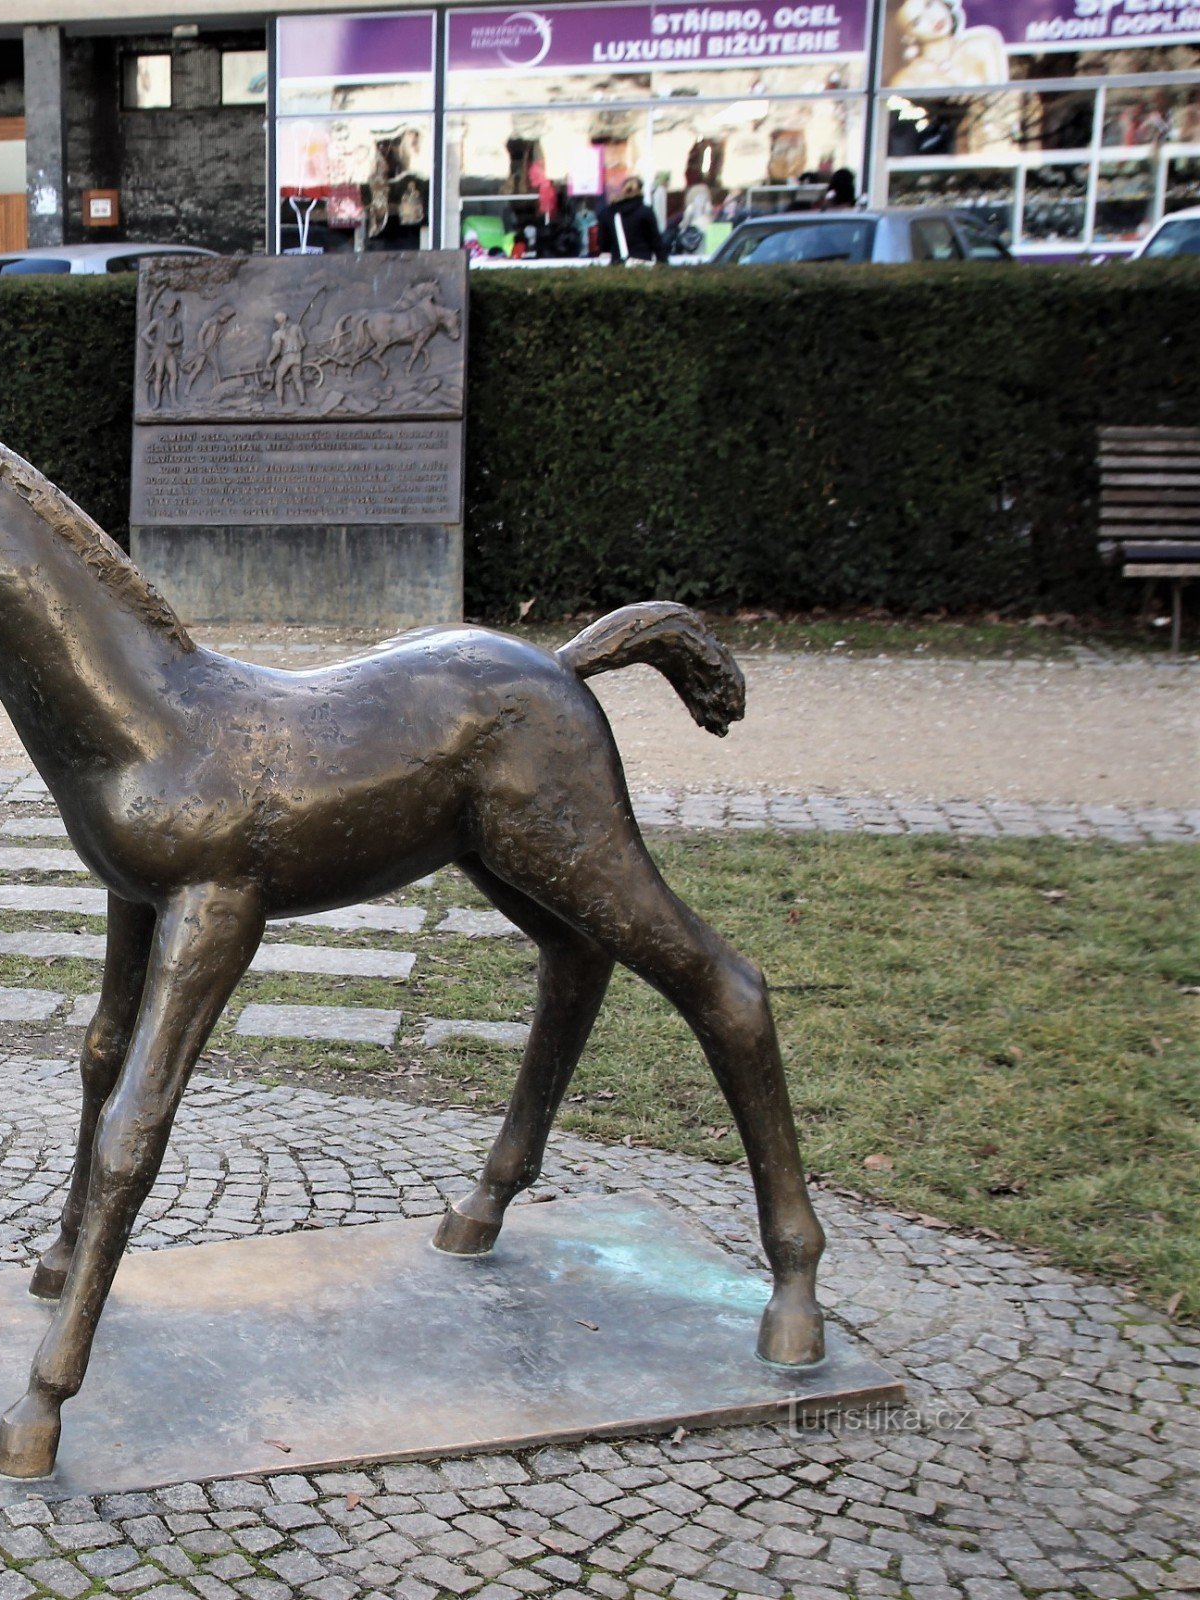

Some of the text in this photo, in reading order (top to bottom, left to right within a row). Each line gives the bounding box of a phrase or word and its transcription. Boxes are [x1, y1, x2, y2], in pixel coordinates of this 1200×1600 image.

[651, 4, 842, 36] STŘÍBRO, OCEL
[1025, 14, 1108, 41] MÓDNÍ
[593, 30, 840, 62] LUXUSNÍ BIŽUTERIE
